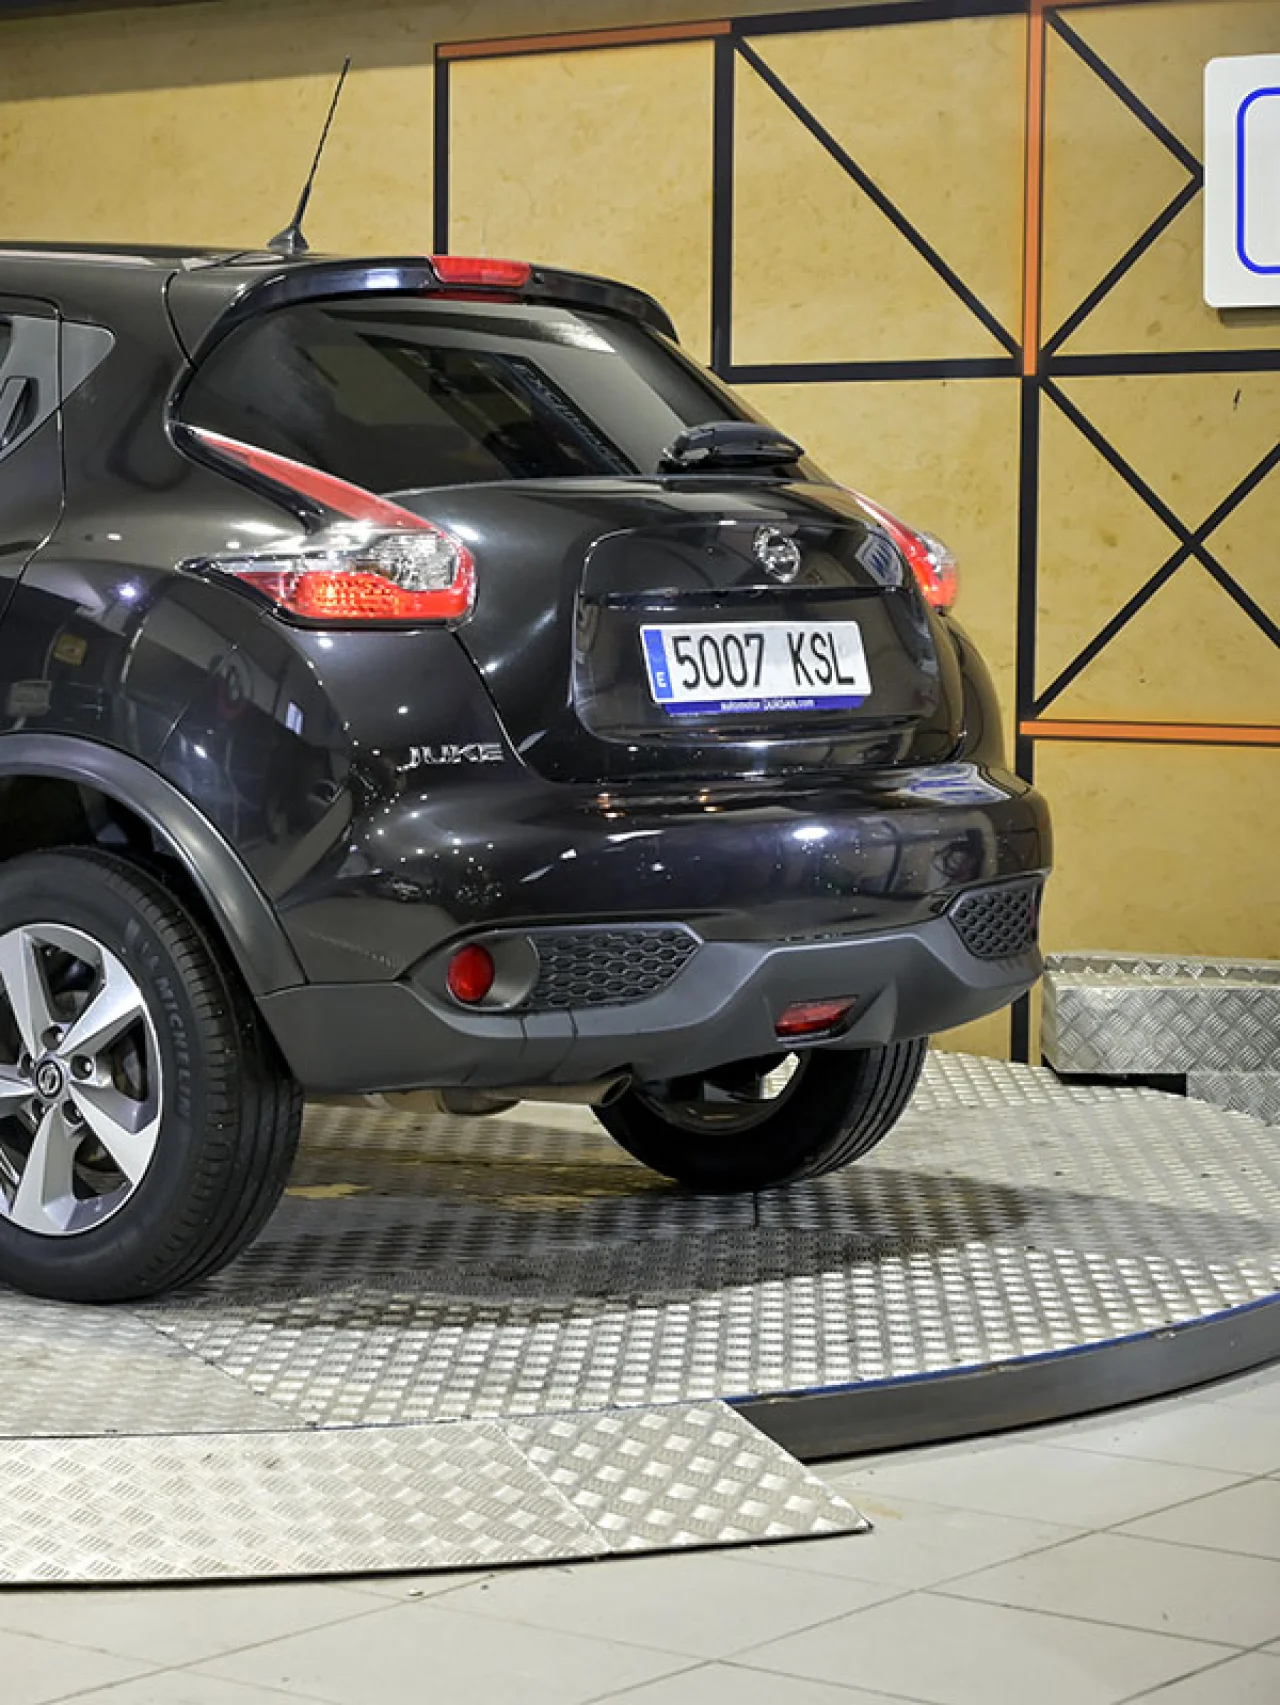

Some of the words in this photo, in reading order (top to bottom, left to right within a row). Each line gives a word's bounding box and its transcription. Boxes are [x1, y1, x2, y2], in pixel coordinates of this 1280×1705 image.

[671, 633, 765, 690] 5007
[786, 631, 856, 686] KSL
[656, 671, 667, 688] E
[396, 742, 505, 771] JUKE
